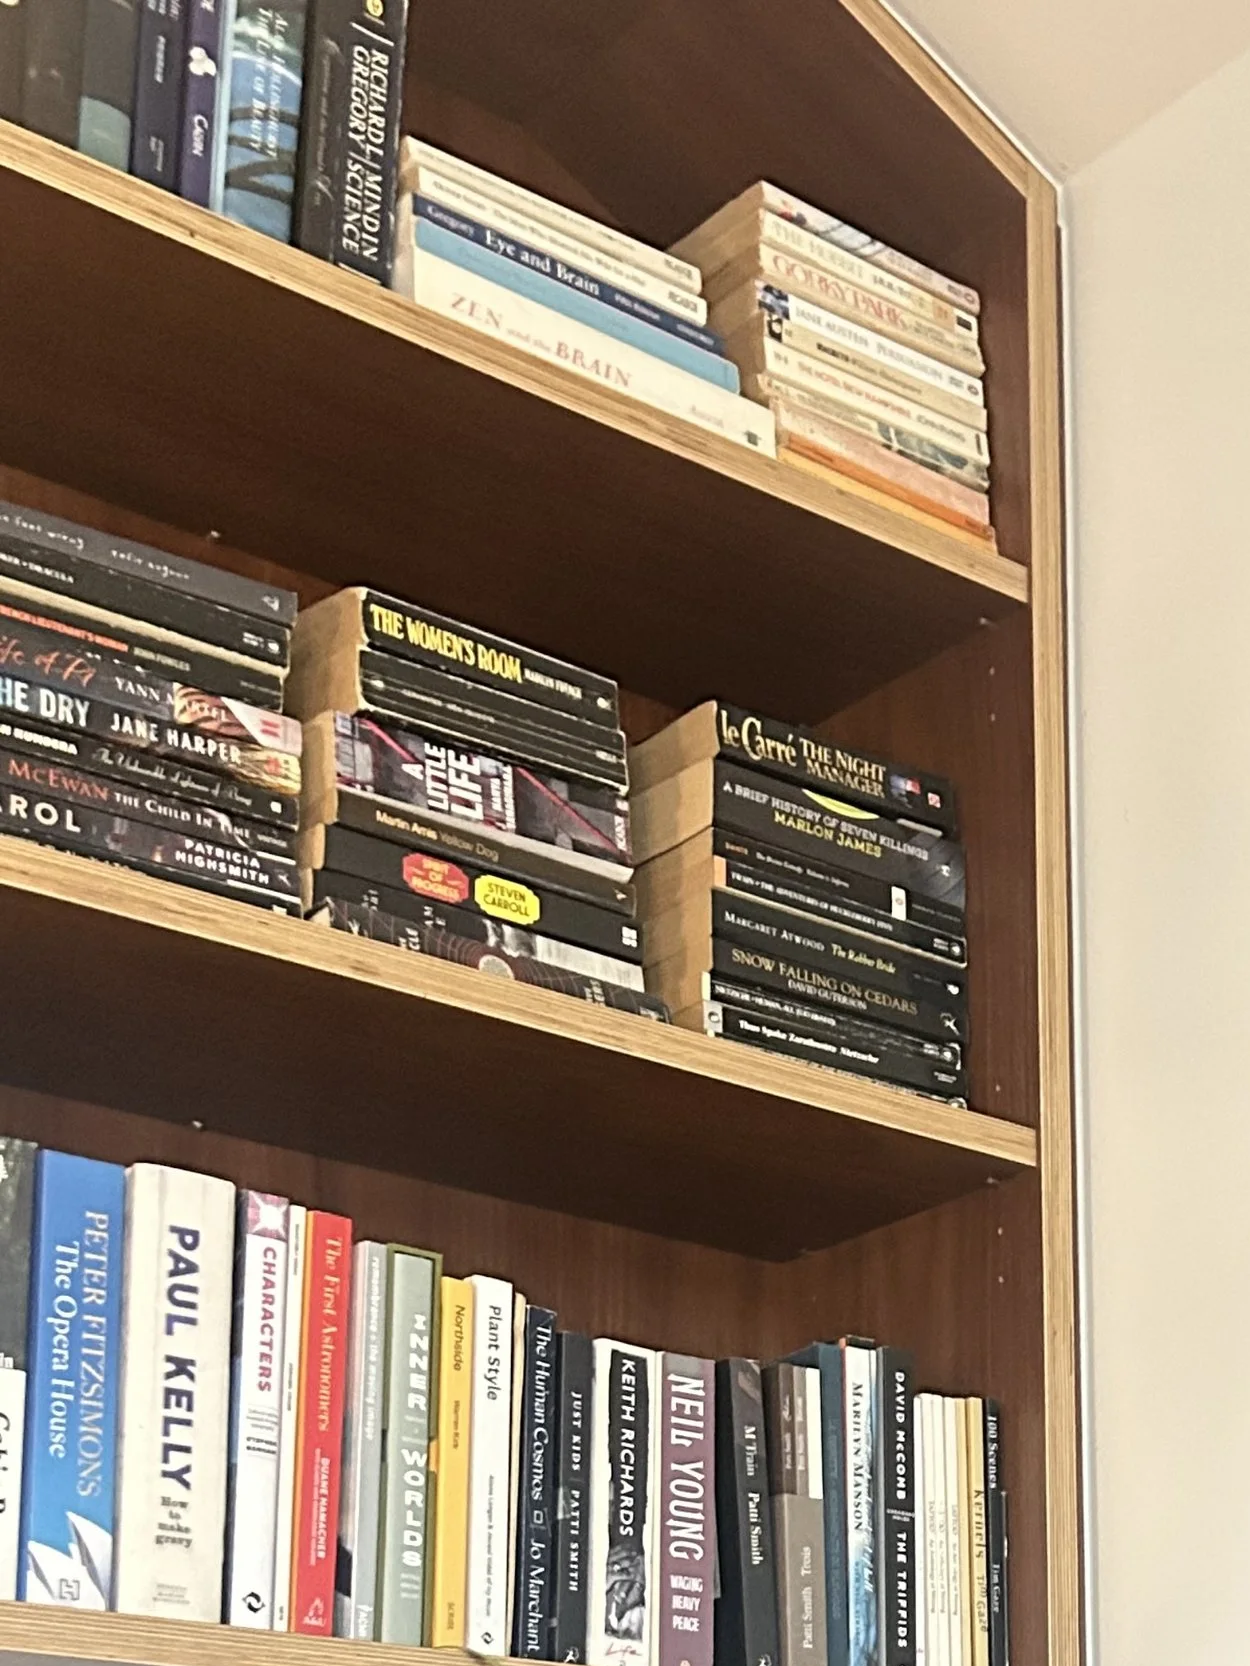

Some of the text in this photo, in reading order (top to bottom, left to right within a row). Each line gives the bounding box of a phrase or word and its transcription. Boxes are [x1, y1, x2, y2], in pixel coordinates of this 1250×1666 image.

[349, 44, 370, 148] GREGORY
[367, 50, 390, 144] RICHARD
[342, 160, 364, 257] SCIENCE
[362, 171, 383, 234] MIND
[484, 229, 517, 257] Eye
[519, 243, 551, 274] and
[556, 263, 601, 296] Brain
[772, 253, 849, 300] GORKY
[851, 291, 908, 330] PARK
[451, 292, 504, 330] ZEN
[555, 341, 632, 389] BRAIN
[795, 306, 825, 329] JANE
[825, 320, 870, 348] AUSTEN
[369, 603, 405, 640] THE
[405, 616, 476, 668] WOMEN'S
[478, 644, 524, 684] ROOM
[114, 676, 161, 701] YANN
[39, 688, 90, 728] DRY
[110, 713, 160, 743] JANE
[166, 728, 242, 765] HARPER
[720, 708, 798, 767] le Carré
[799, 736, 887, 782] THE NIGHT
[401, 763, 425, 781] A
[423, 742, 450, 812] LITTLE
[449, 749, 485, 821] LIFE
[806, 758, 887, 799] MANAGER
[0, 794, 81, 834] ROL
[375, 810, 499, 862] Martin Amis Yellow Dog
[722, 780, 930, 861] A BRIEF HISTORY OF SEVEN KILLINGS
[773, 811, 883, 858] MARLON JAMES
[174, 850, 270, 885] HIGHSMITH
[184, 838, 261, 869] PATRICIA
[483, 893, 531, 918] CARROLL
[486, 881, 527, 904] STEVEN
[723, 909, 778, 938] MARGARET
[780, 928, 826, 952] ATWOOD
[731, 948, 919, 1016] SNOW FALLING ON CEDARS
[787, 978, 818, 997] DAVID
[46, 1240, 80, 1459] The Opera House
[258, 1246, 277, 1392] CHARACTERS
[318, 1235, 342, 1433] The First Astronomers
[453, 1304, 467, 1372] Northside
[76, 1210, 109, 1497] PETER FITZSIMONS
[160, 1224, 200, 1491] PAUL KELLY
[407, 1313, 430, 1413] INNER
[484, 1304, 504, 1402] Plant Style
[894, 1371, 906, 1423] DAVID
[986, 1415, 998, 1439] 100
[318, 1456, 331, 1497] DUANE
[619, 1358, 637, 1537] KEITH RICHARDS
[665, 1373, 706, 1561] NEIL YOUNG
[852, 1382, 865, 1531] MARILYN MANSON
[988, 1442, 999, 1489] Scenes
[160, 1496, 189, 1510] How
[168, 1509, 182, 1521] to
[400, 1448, 428, 1568] WORLDS
[527, 1325, 552, 1652] The Human Cosmos Jo Marchant
[568, 1391, 583, 1592] JUST KIDS PATTI SMITH
[744, 1425, 764, 1565] M Train Patti Smith
[155, 1533, 193, 1549] gravy
[157, 1522, 192, 1534] make
[973, 1489, 987, 1559] Kernels
[669, 1574, 704, 1592] WAGING
[671, 1594, 701, 1612] HEAVY
[801, 1586, 813, 1621] Smith
[896, 1531, 909, 1648] THE TRIFFIDS
[672, 1615, 701, 1633] PEACE
[802, 1621, 813, 1649] Patti
